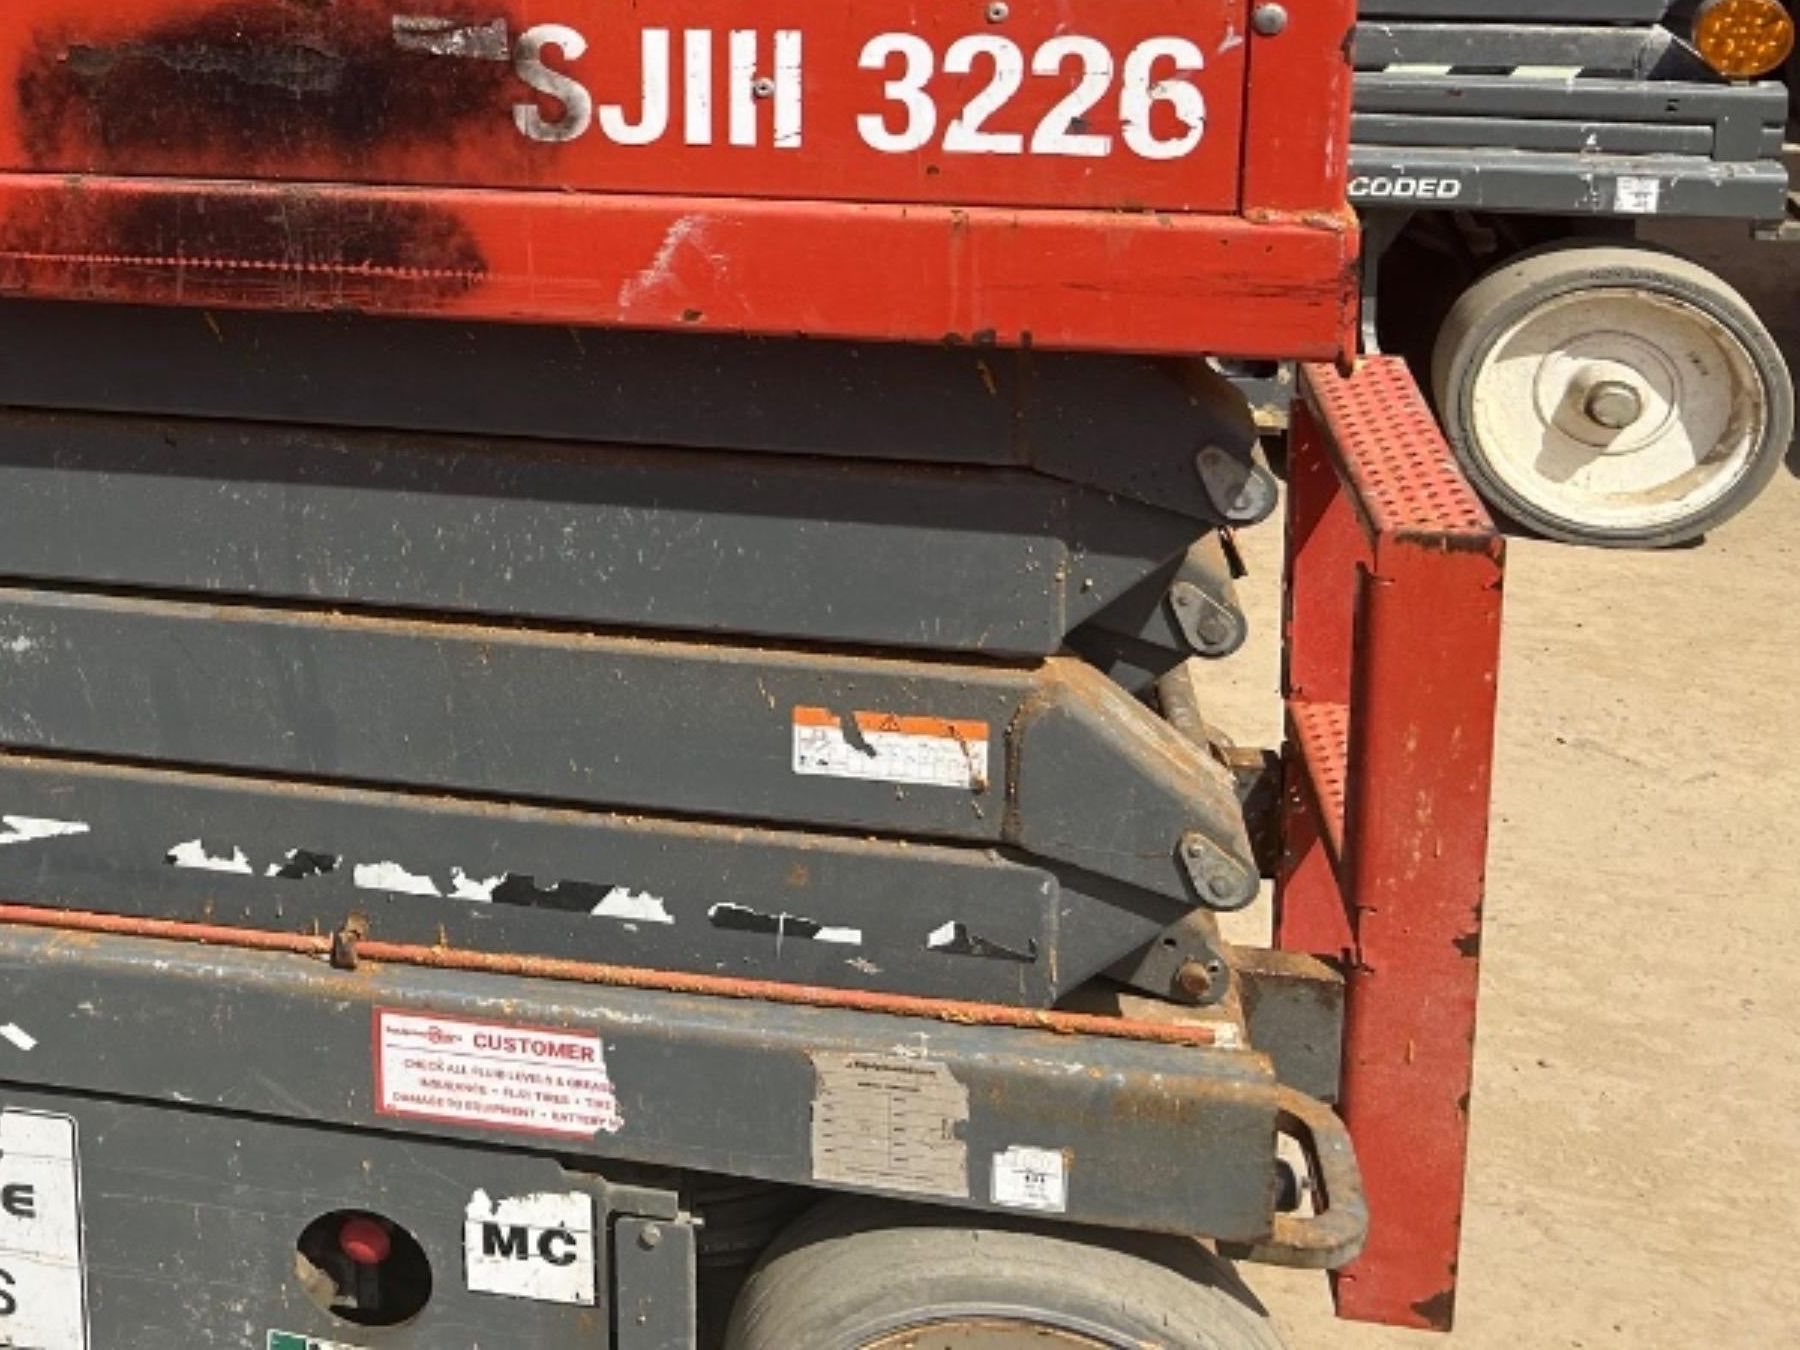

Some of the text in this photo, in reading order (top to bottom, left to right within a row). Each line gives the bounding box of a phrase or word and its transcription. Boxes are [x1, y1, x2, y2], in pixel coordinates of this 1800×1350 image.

[857, 32, 1205, 159] 3226
[1347, 176, 1461, 199] CODED
[473, 1032, 595, 1063] CUSTOMER
[481, 1220, 577, 1266] MC
